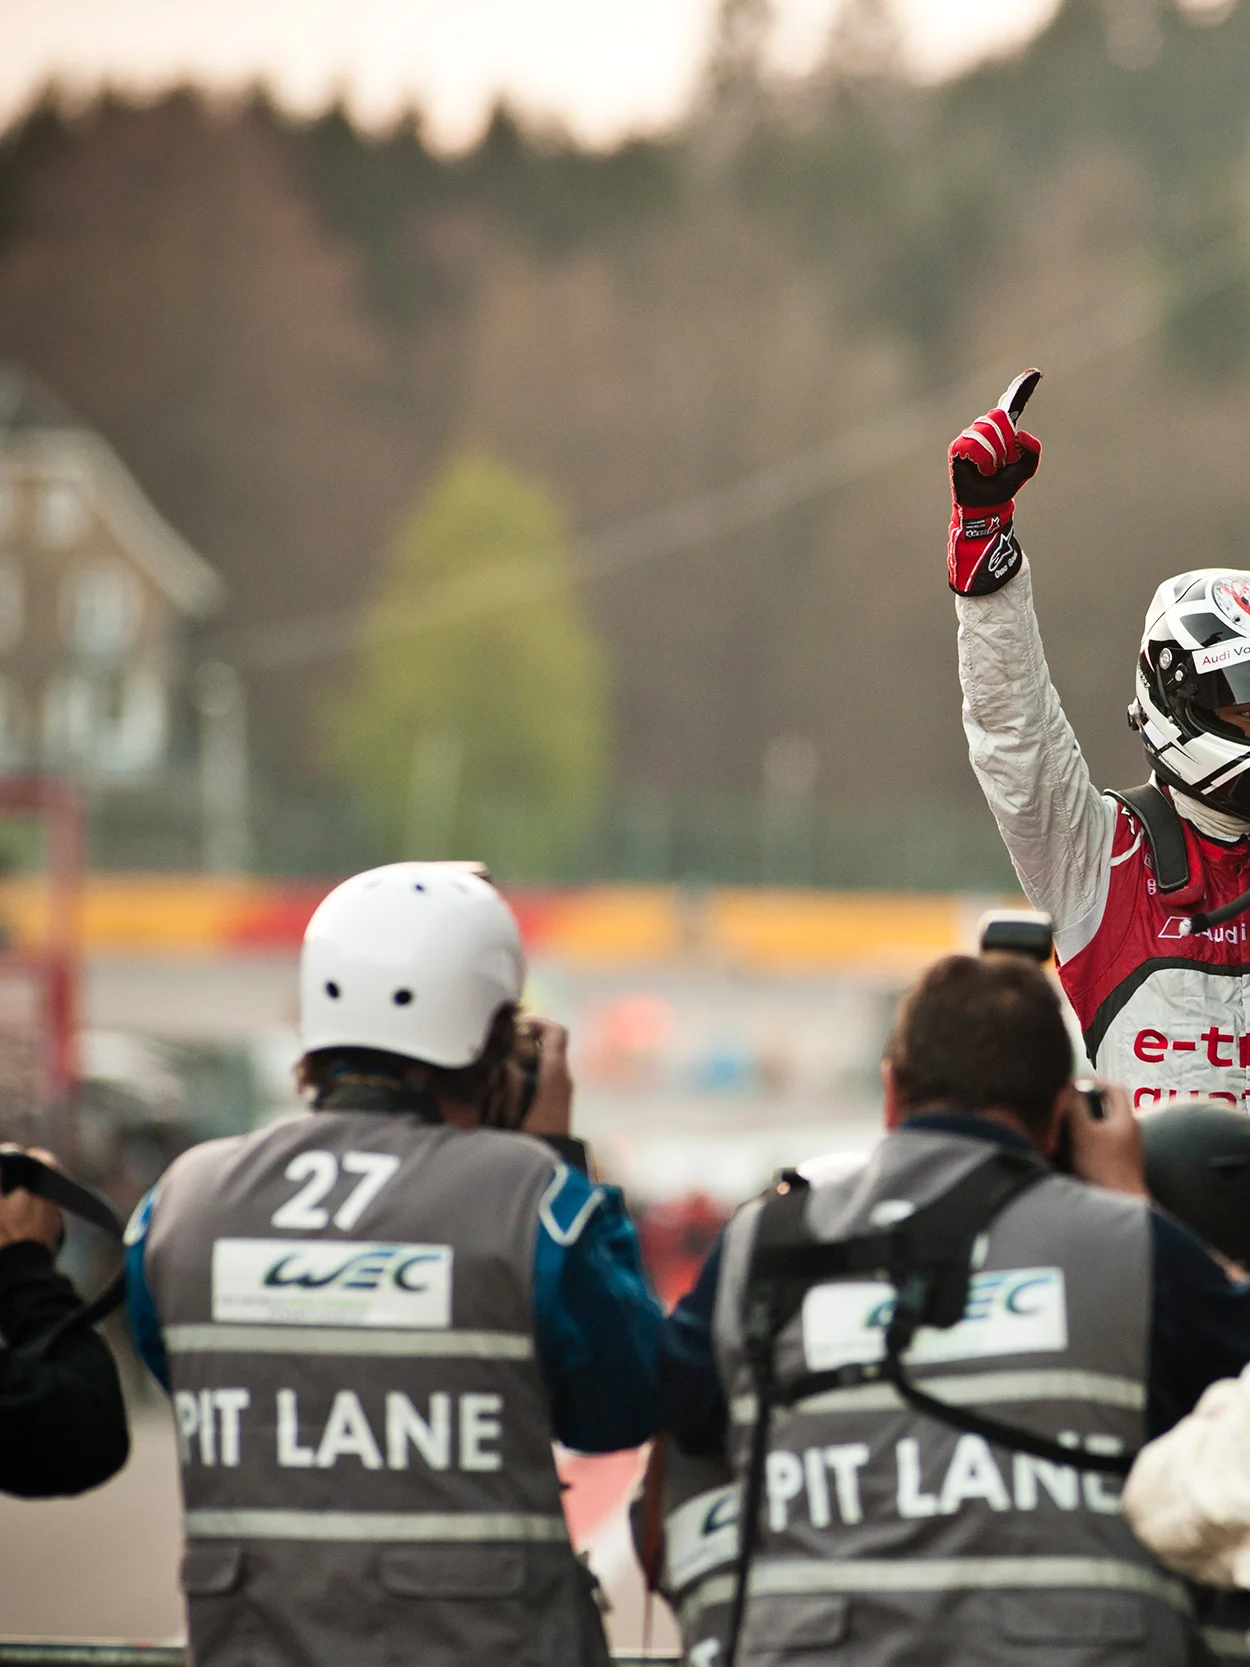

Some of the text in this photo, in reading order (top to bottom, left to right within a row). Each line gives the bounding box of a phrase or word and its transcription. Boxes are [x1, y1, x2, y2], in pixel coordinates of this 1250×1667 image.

[1202, 650, 1231, 666] Audi
[272, 1150, 400, 1231] 27
[263, 1248, 443, 1292] WEC
[175, 1387, 502, 1472] PIT LANE
[766, 1443, 870, 1533] PIT
